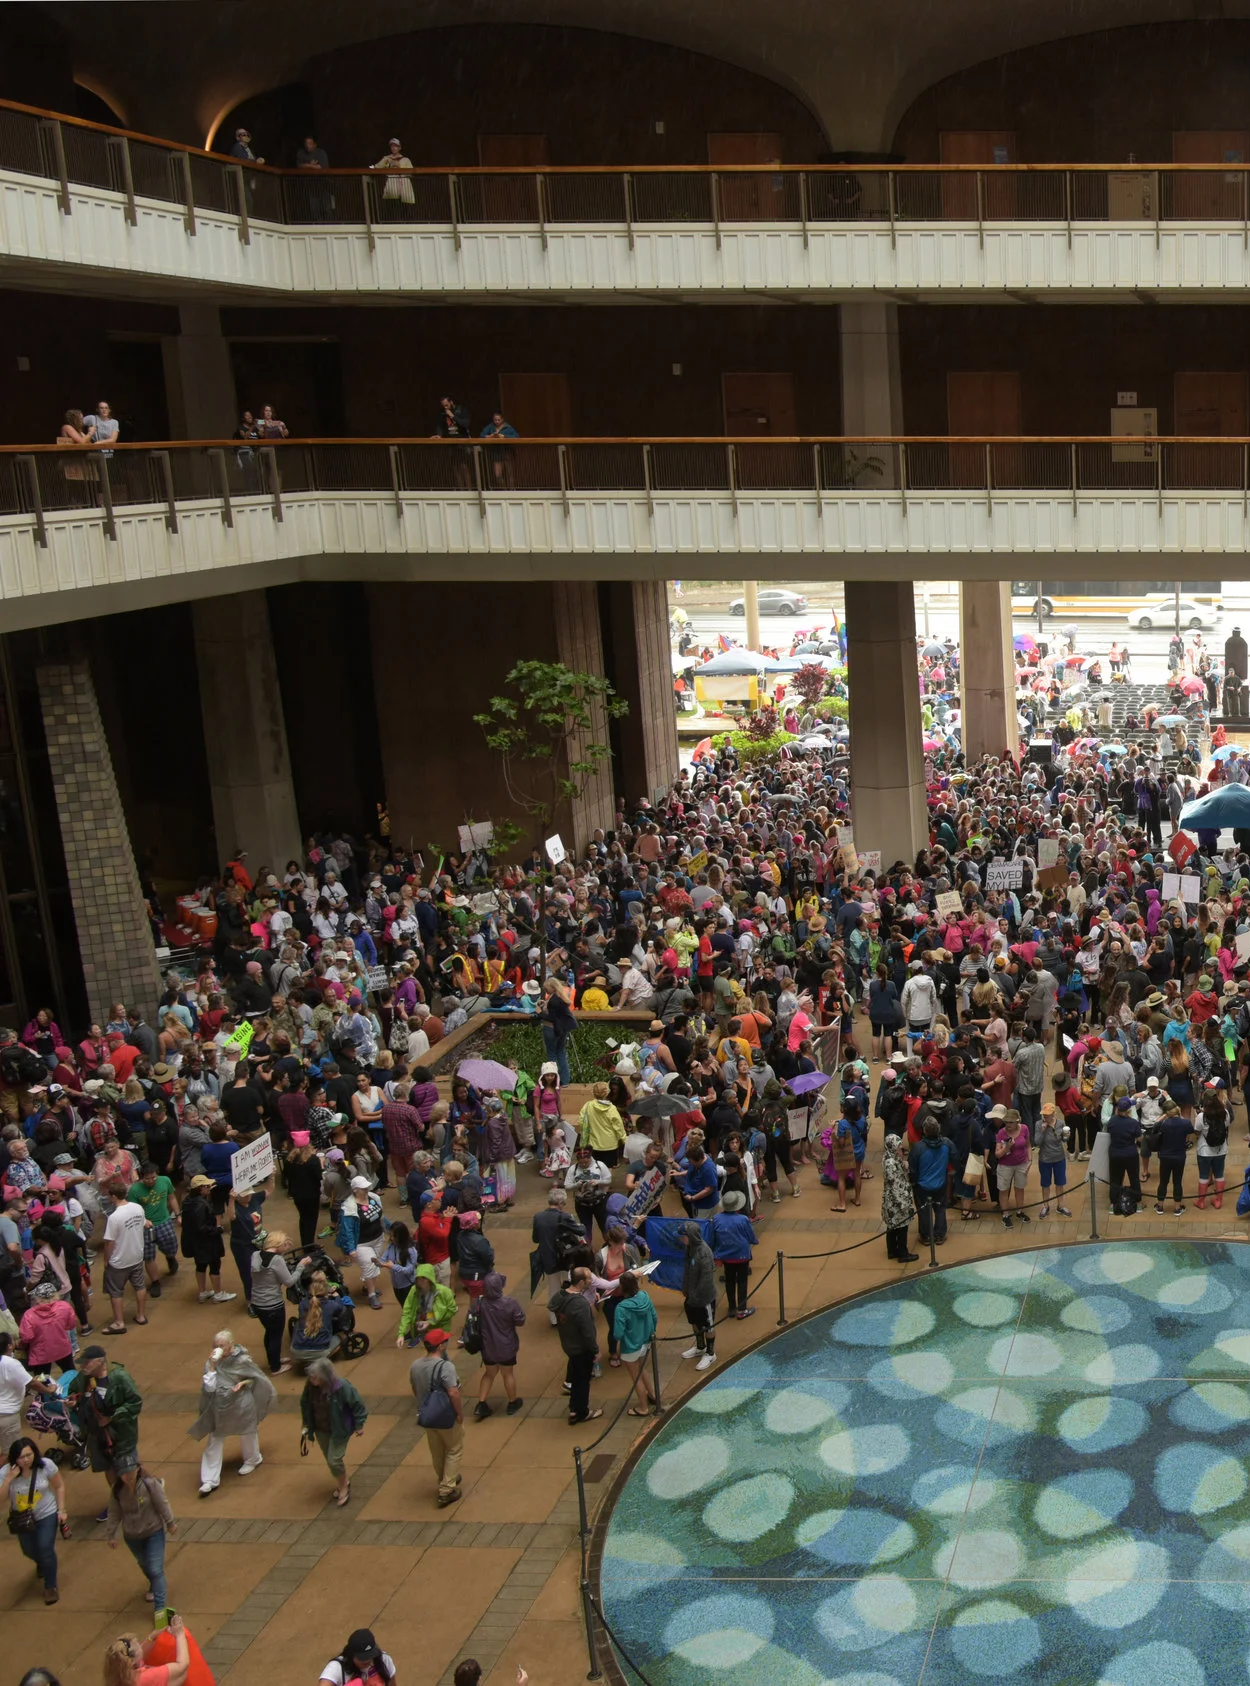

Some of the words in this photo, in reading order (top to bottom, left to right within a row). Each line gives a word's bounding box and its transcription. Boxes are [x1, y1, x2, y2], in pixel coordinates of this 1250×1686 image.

[987, 870, 1022, 880] SAVED
[986, 881, 1001, 890] MY
[234, 1156, 239, 1168] I
[240, 1150, 251, 1164] AM
